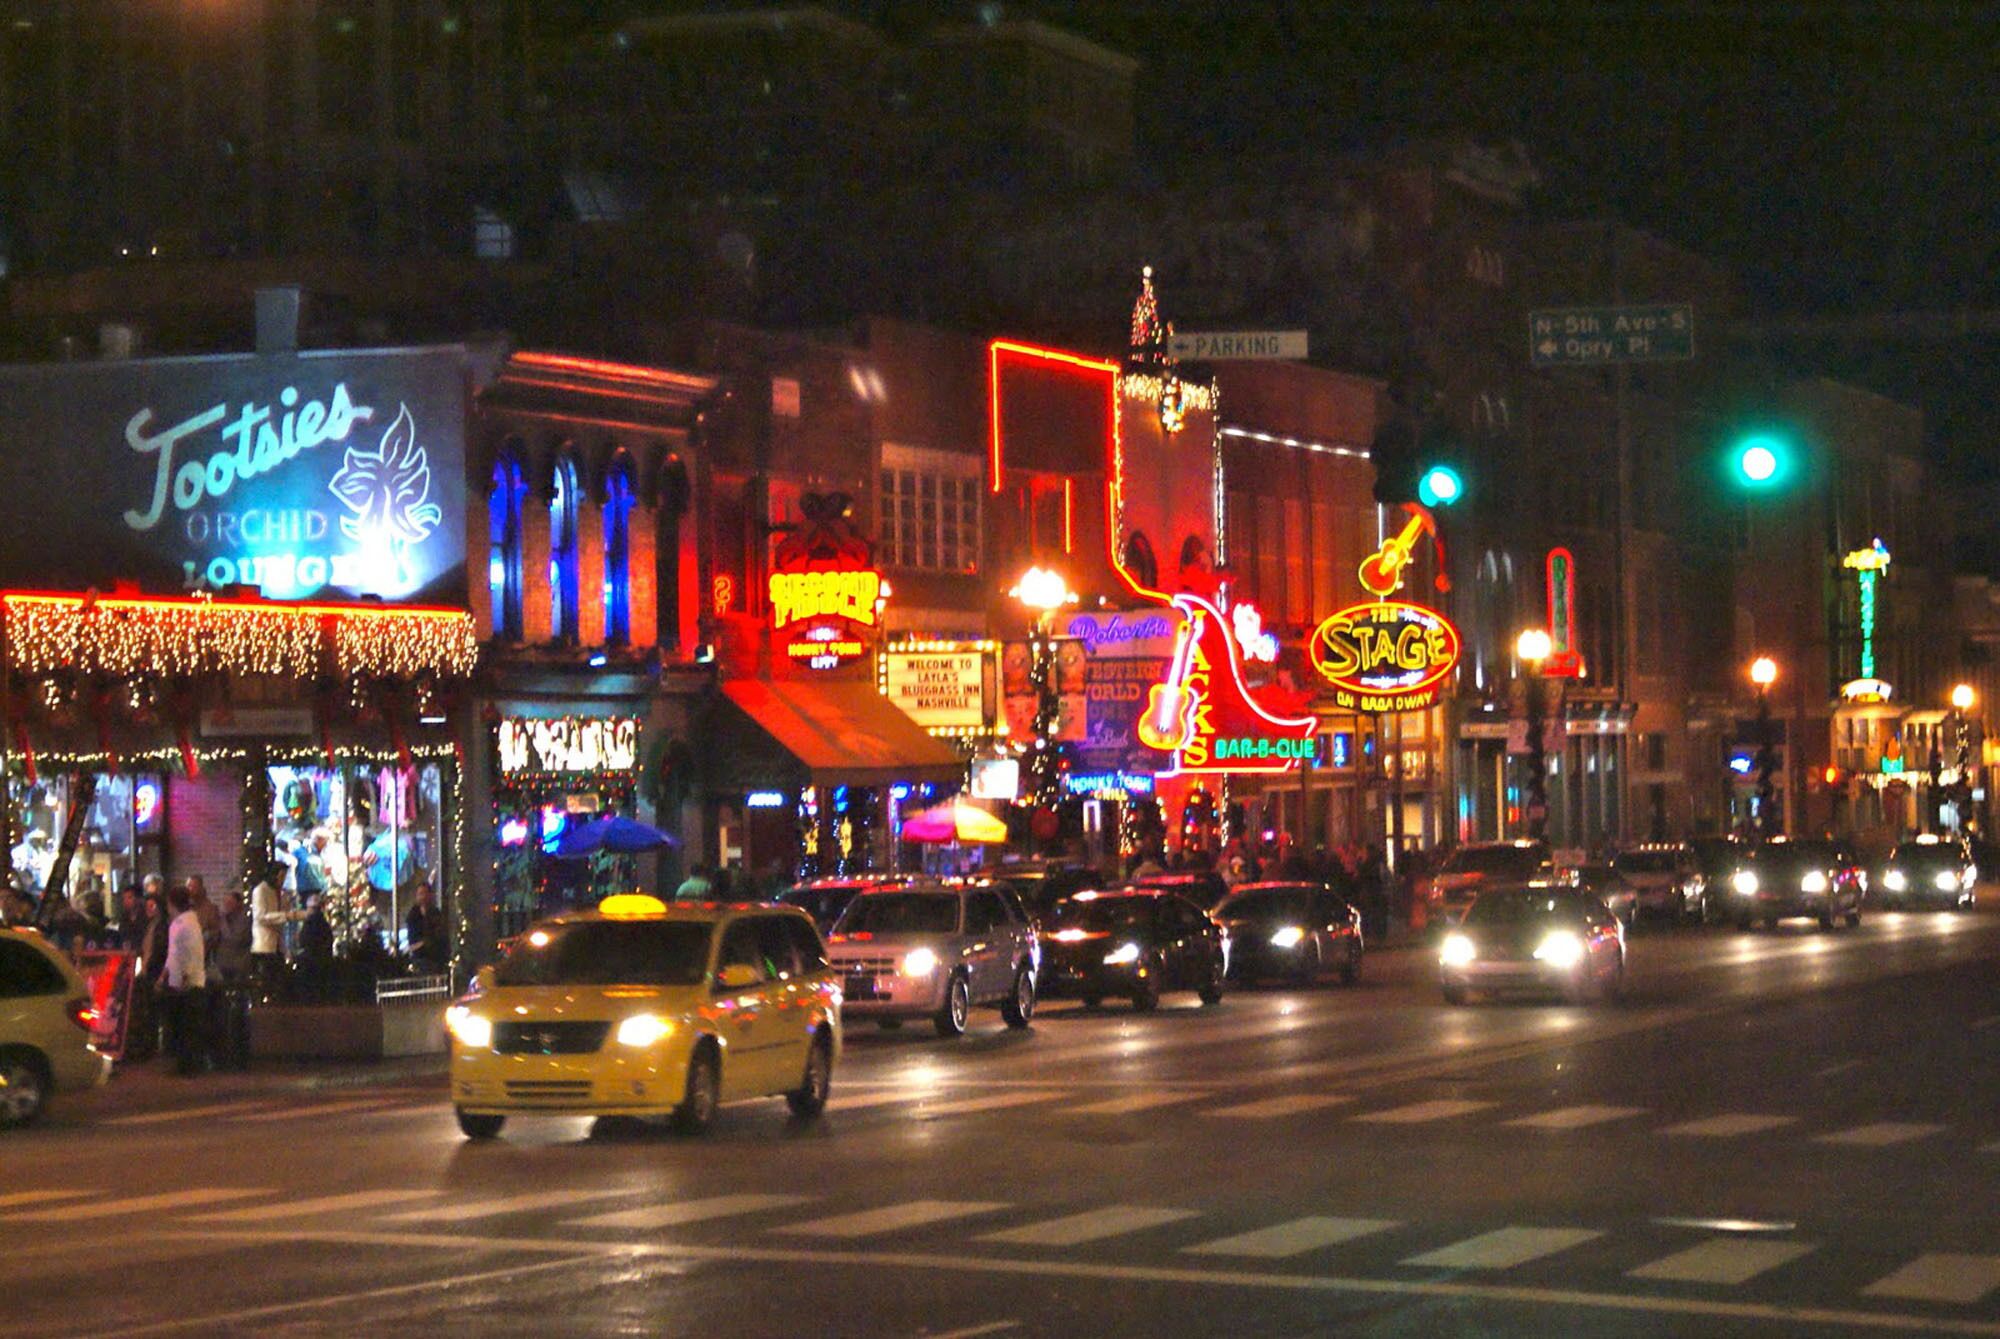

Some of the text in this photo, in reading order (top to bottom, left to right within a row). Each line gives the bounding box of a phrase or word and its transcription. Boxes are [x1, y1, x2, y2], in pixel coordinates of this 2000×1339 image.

[1195, 336, 1280, 357] PARKING
[1565, 339, 1613, 359] Opry
[123, 382, 374, 530] Tootsies
[186, 509, 328, 547] ORCHID
[1321, 617, 1453, 678] STAGE
[907, 660, 973, 671] WELCOME TO
[918, 673, 959, 683] LAYLA'S
[902, 684, 980, 697] BLUEGRASS INN
[1336, 690, 1434, 712] ON BROADWAY
[917, 699, 969, 709] NASHVILLE
[1215, 739, 1315, 760] BAR-B-QUE
